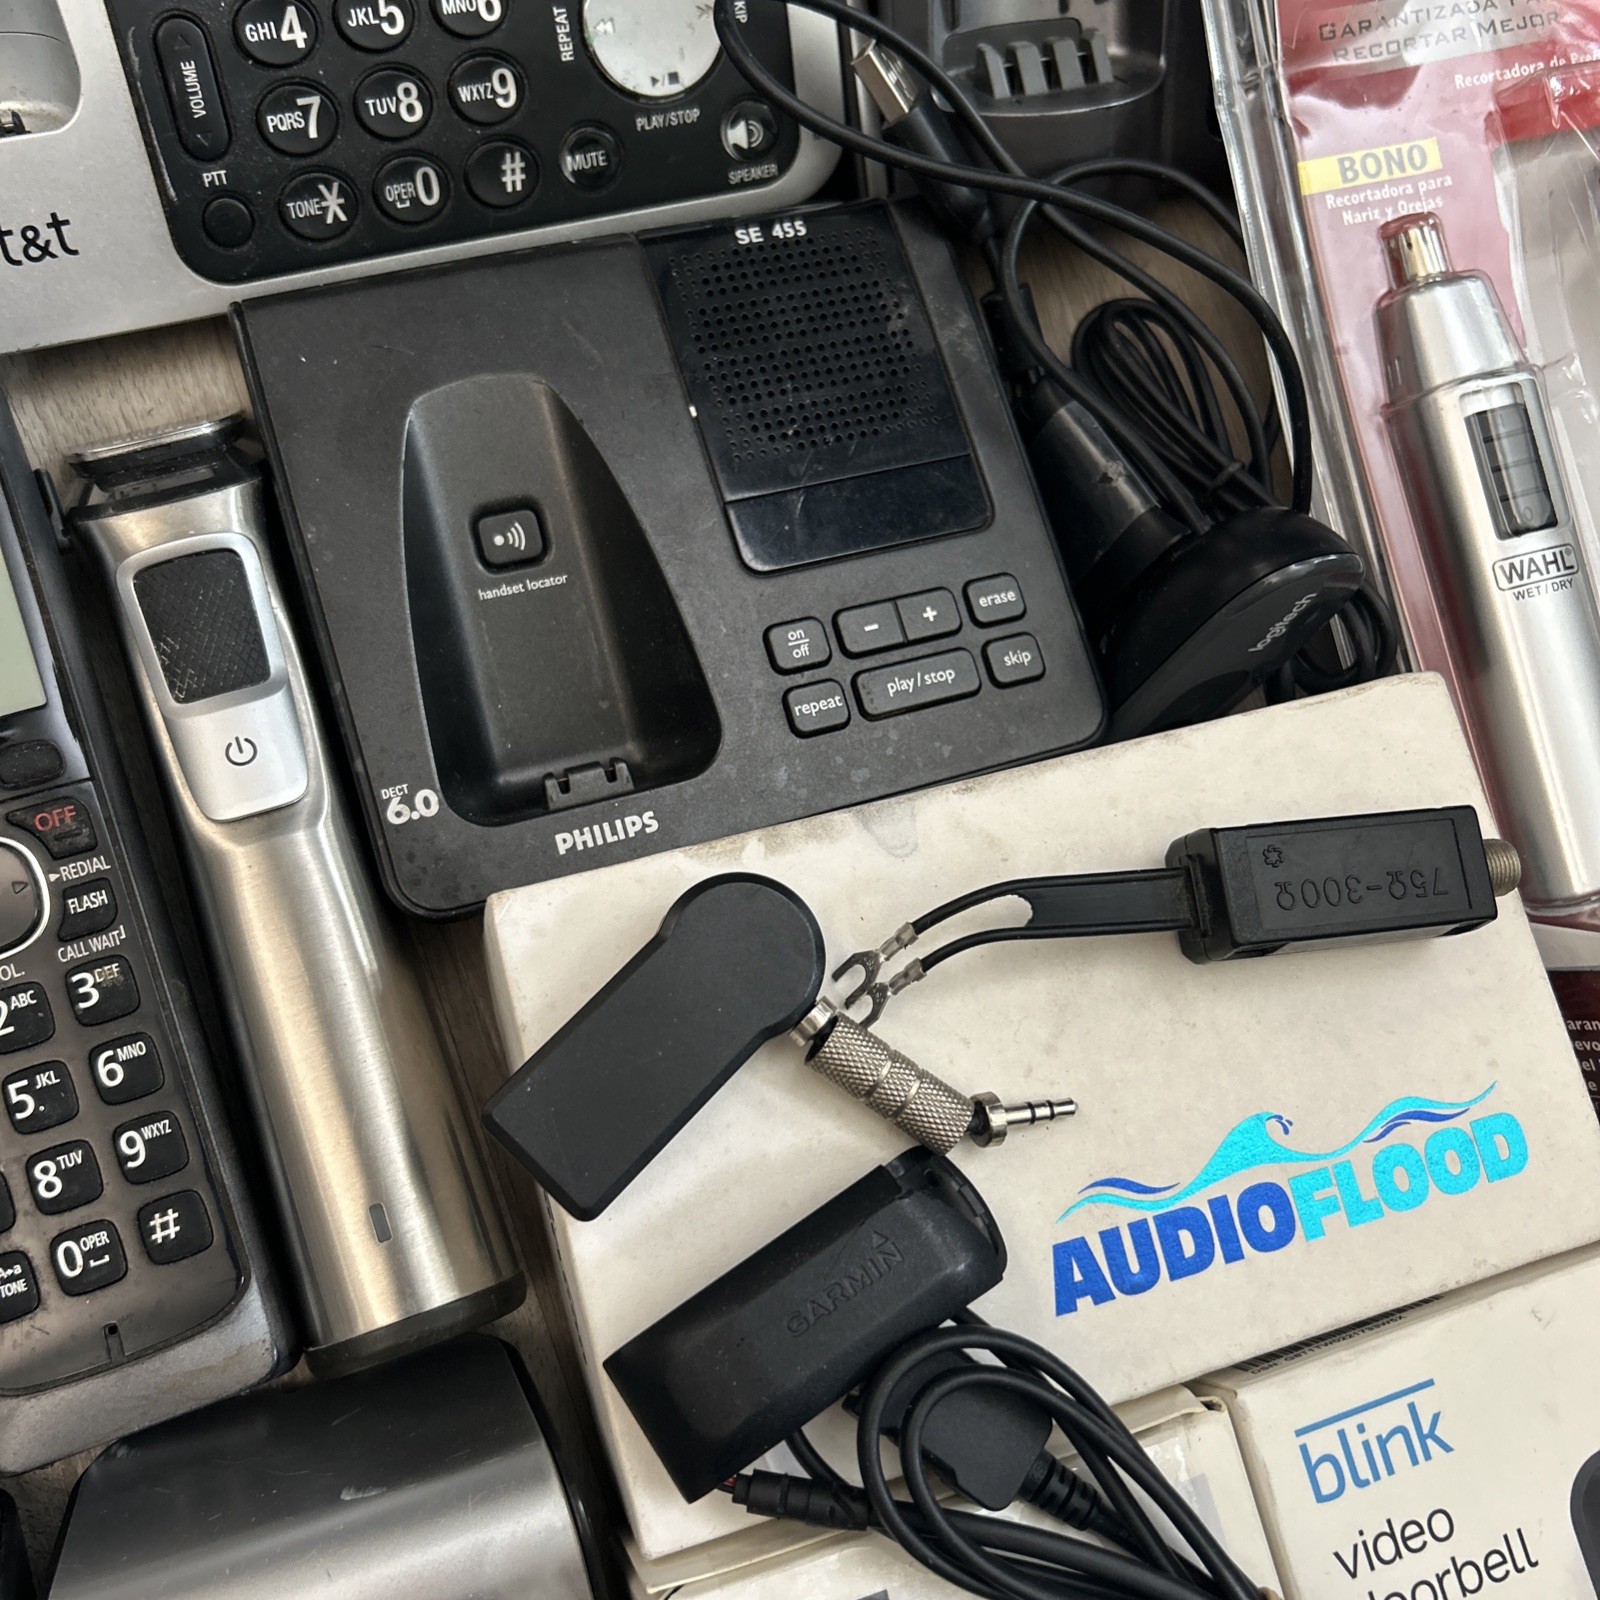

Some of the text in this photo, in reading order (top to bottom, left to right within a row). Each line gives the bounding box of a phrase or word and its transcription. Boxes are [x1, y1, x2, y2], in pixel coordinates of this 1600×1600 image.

[348, 0, 405, 35] JKL 5
[442, 0, 477, 15] MNO
[245, 6, 307, 48] GHI 4
[553, 6, 574, 62] REPEAT
[1331, 11, 1562, 62] RECORTAR MEJOR
[180, 60, 207, 119] VOLUME
[458, 67, 517, 108] WXYZ 9
[1454, 60, 1544, 90] Recortadora
[266, 95, 321, 139] PQRS 7
[364, 82, 422, 123] TUV 8
[635, 108, 700, 132] PLAY/STOP
[203, 170, 228, 187] PTT
[501, 151, 526, 193] #
[566, 149, 608, 172] MUTE
[728, 164, 779, 185] SPEAKER
[1337, 144, 1428, 184] BONO
[384, 166, 440, 206] OPER 0
[1325, 175, 1453, 209] Recortadora para
[1341, 195, 1443, 226] Nariz y Orejas
[734, 221, 808, 246] SE 455
[478, 573, 568, 600] handset locator
[978, 589, 1017, 608] erase
[787, 628, 805, 641] on
[1247, 593, 1318, 652] logitech
[792, 644, 810, 659] off
[1004, 650, 1032, 667] skip
[794, 695, 844, 717] repeat
[381, 784, 409, 799] DECT
[386, 789, 440, 825] 6.0
[34, 805, 76, 831] OFF
[554, 811, 660, 855] PHILIPS
[59, 855, 111, 881] REDIAL
[67, 889, 109, 914] FLASH
[57, 930, 121, 962] CALL WAIT
[10, 990, 37, 1011] ABC
[70, 963, 120, 1009] 3 DEF
[97, 1041, 147, 1088] 6 MNO
[7, 1070, 61, 1120] 5 JKL
[119, 1119, 172, 1168] 9 WXYZ
[33, 1150, 83, 1198] 8 TUV
[149, 1208, 181, 1244] #
[1052, 1112, 1529, 1317] AUDIOFLOOD
[57, 1231, 110, 1277] 0 OPER
[0, 1279, 28, 1298] TONE
[787, 1242, 905, 1336] GARMIN
[1299, 1401, 1455, 1504] blink
[1333, 1508, 1455, 1580] video
[1368, 1528, 1539, 1600] orbell
